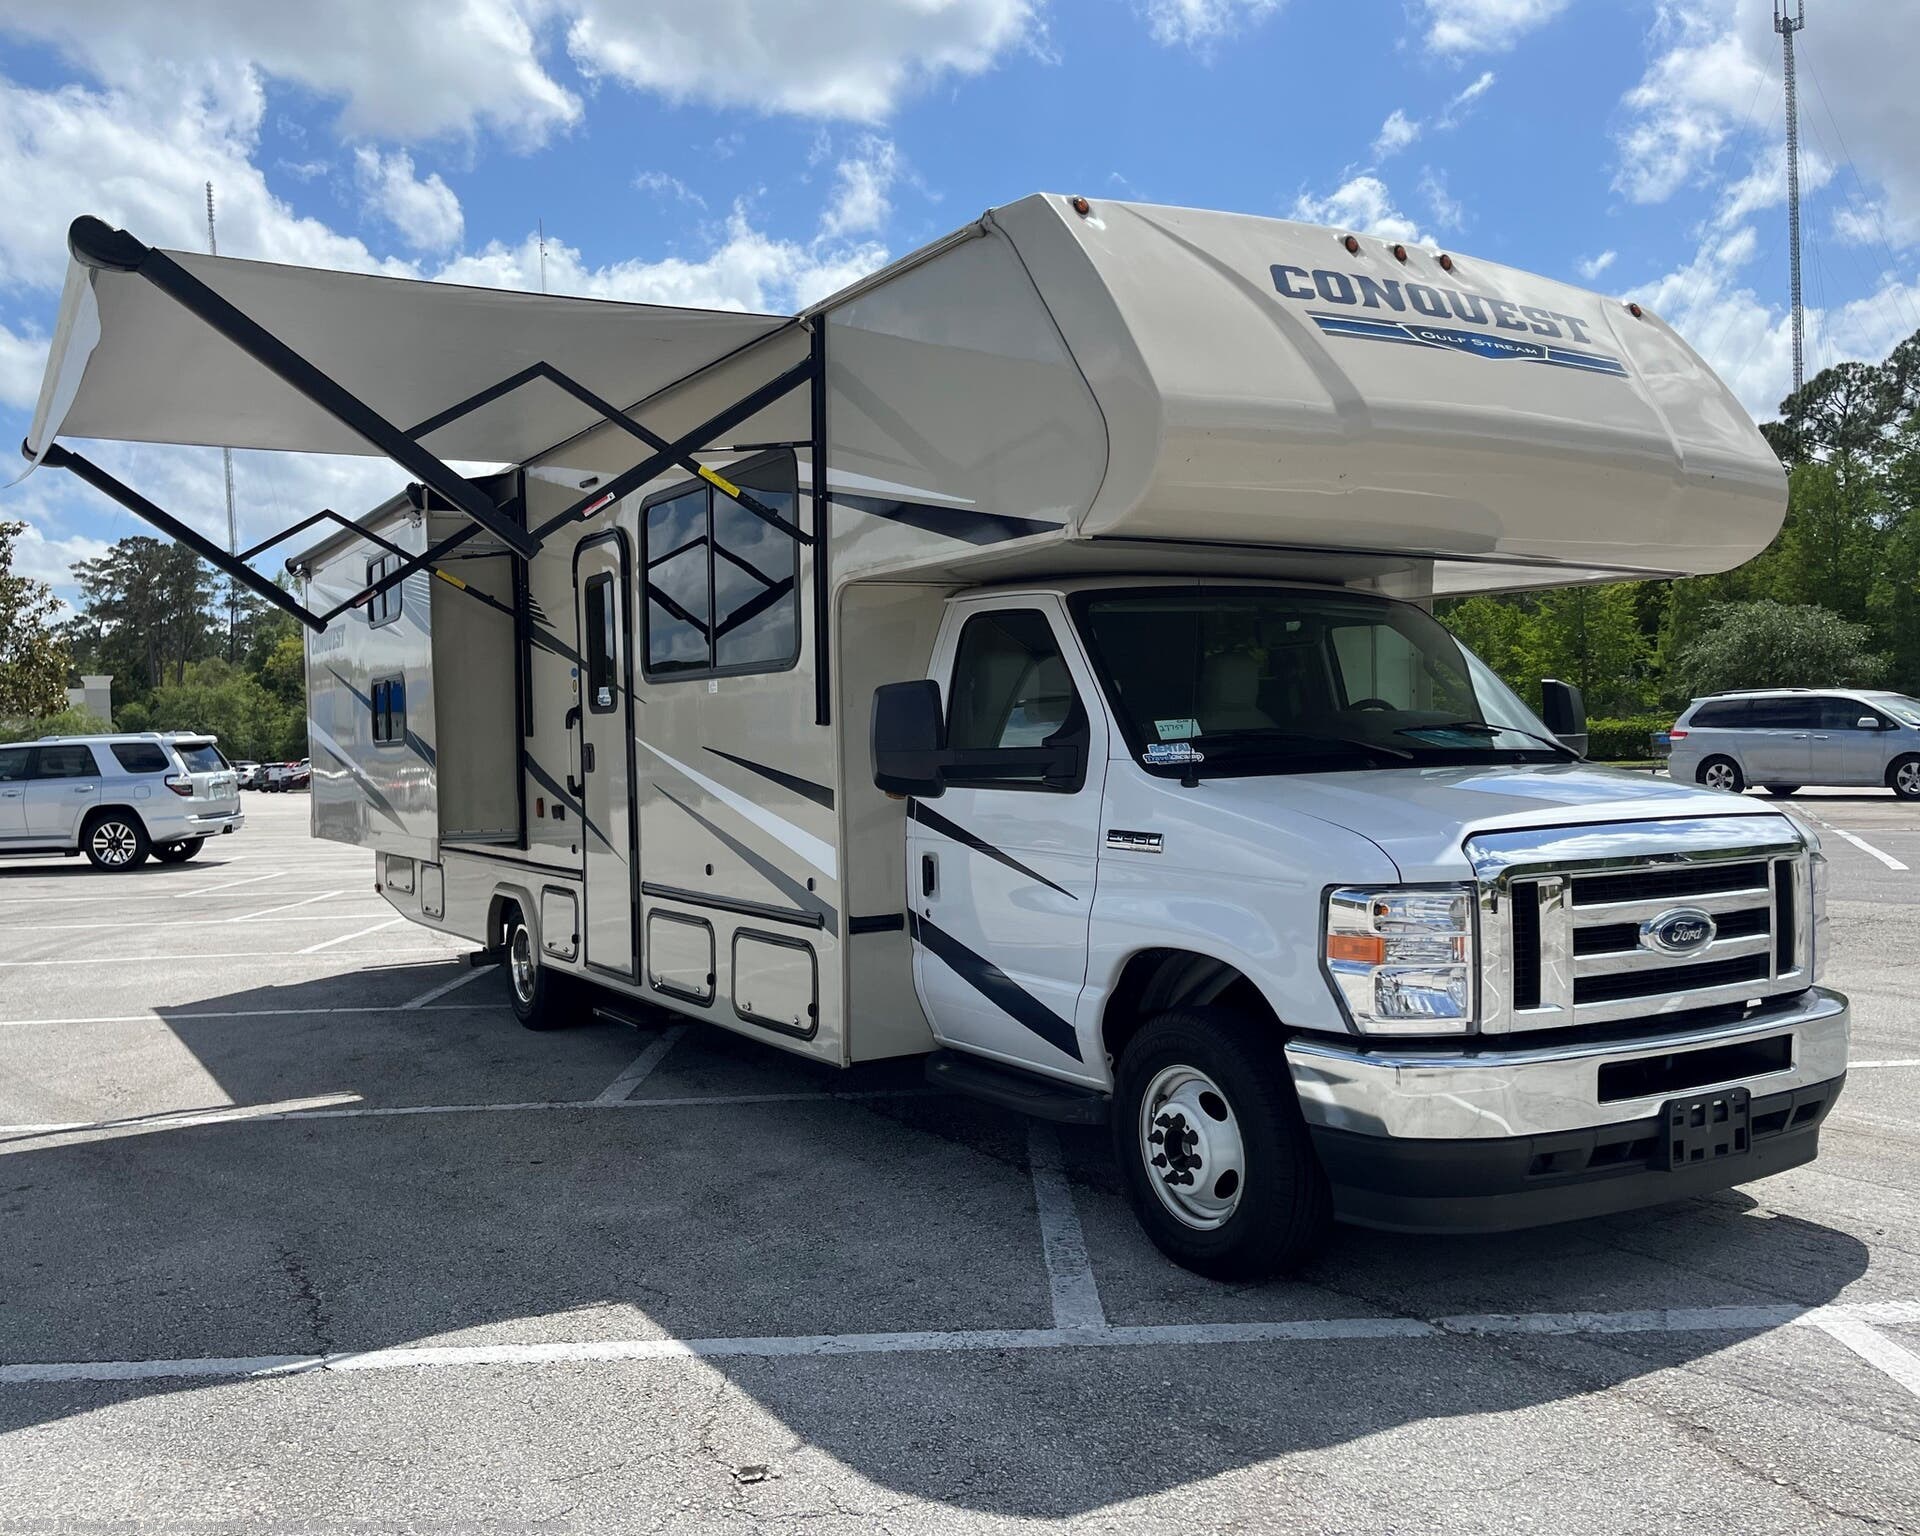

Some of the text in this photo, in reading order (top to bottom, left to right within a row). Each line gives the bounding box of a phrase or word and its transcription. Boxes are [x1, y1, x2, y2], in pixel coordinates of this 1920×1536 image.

[1269, 263, 1593, 345] CONQUEST
[1420, 331, 1538, 355] GULF STREAM
[1148, 743, 1191, 754] RENTAL
[1671, 921, 1703, 942] Ford
